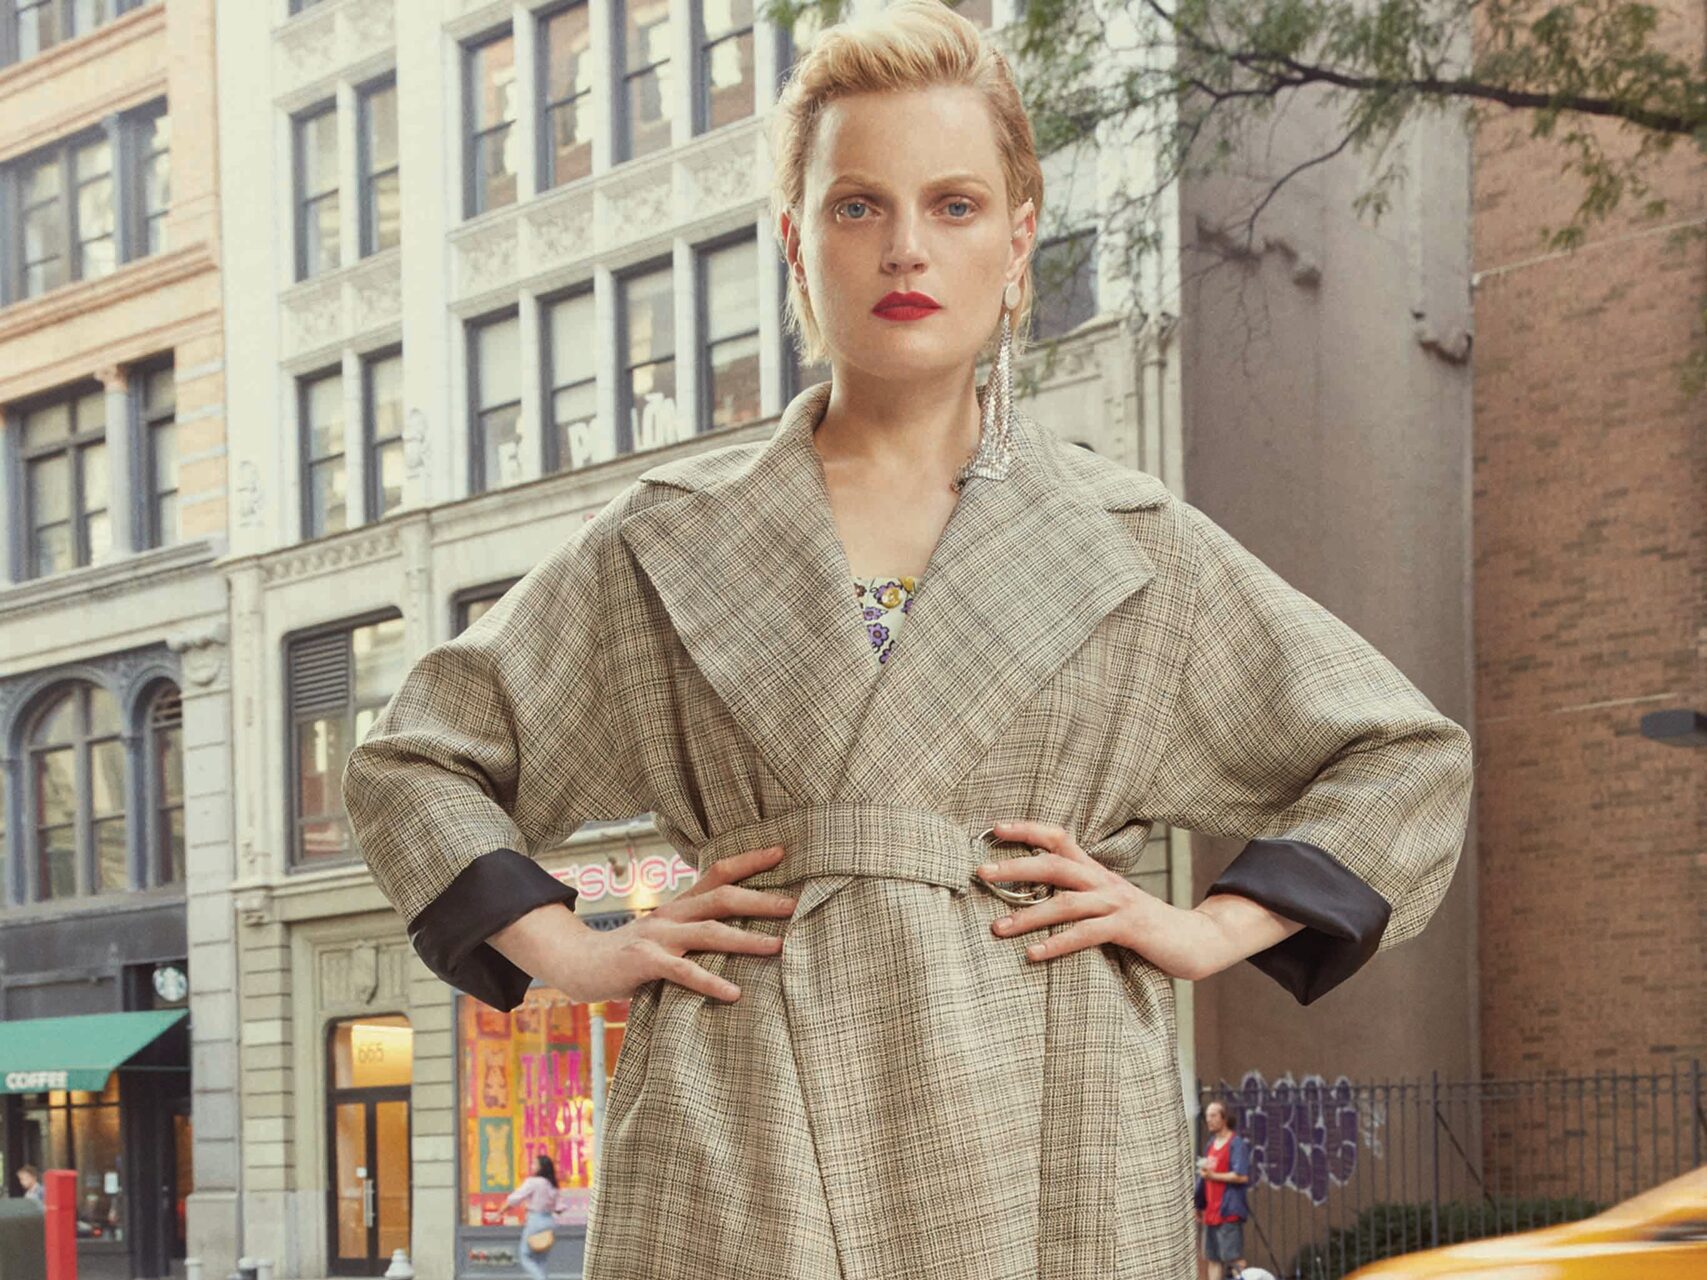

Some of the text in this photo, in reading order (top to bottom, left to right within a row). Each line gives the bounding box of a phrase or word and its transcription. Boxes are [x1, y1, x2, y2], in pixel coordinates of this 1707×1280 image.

[550, 848, 699, 900] 'SUGA
[5, 1070, 69, 1090] COFFEE
[521, 1049, 584, 1099] TALK
[524, 1100, 585, 1138] NERDY
